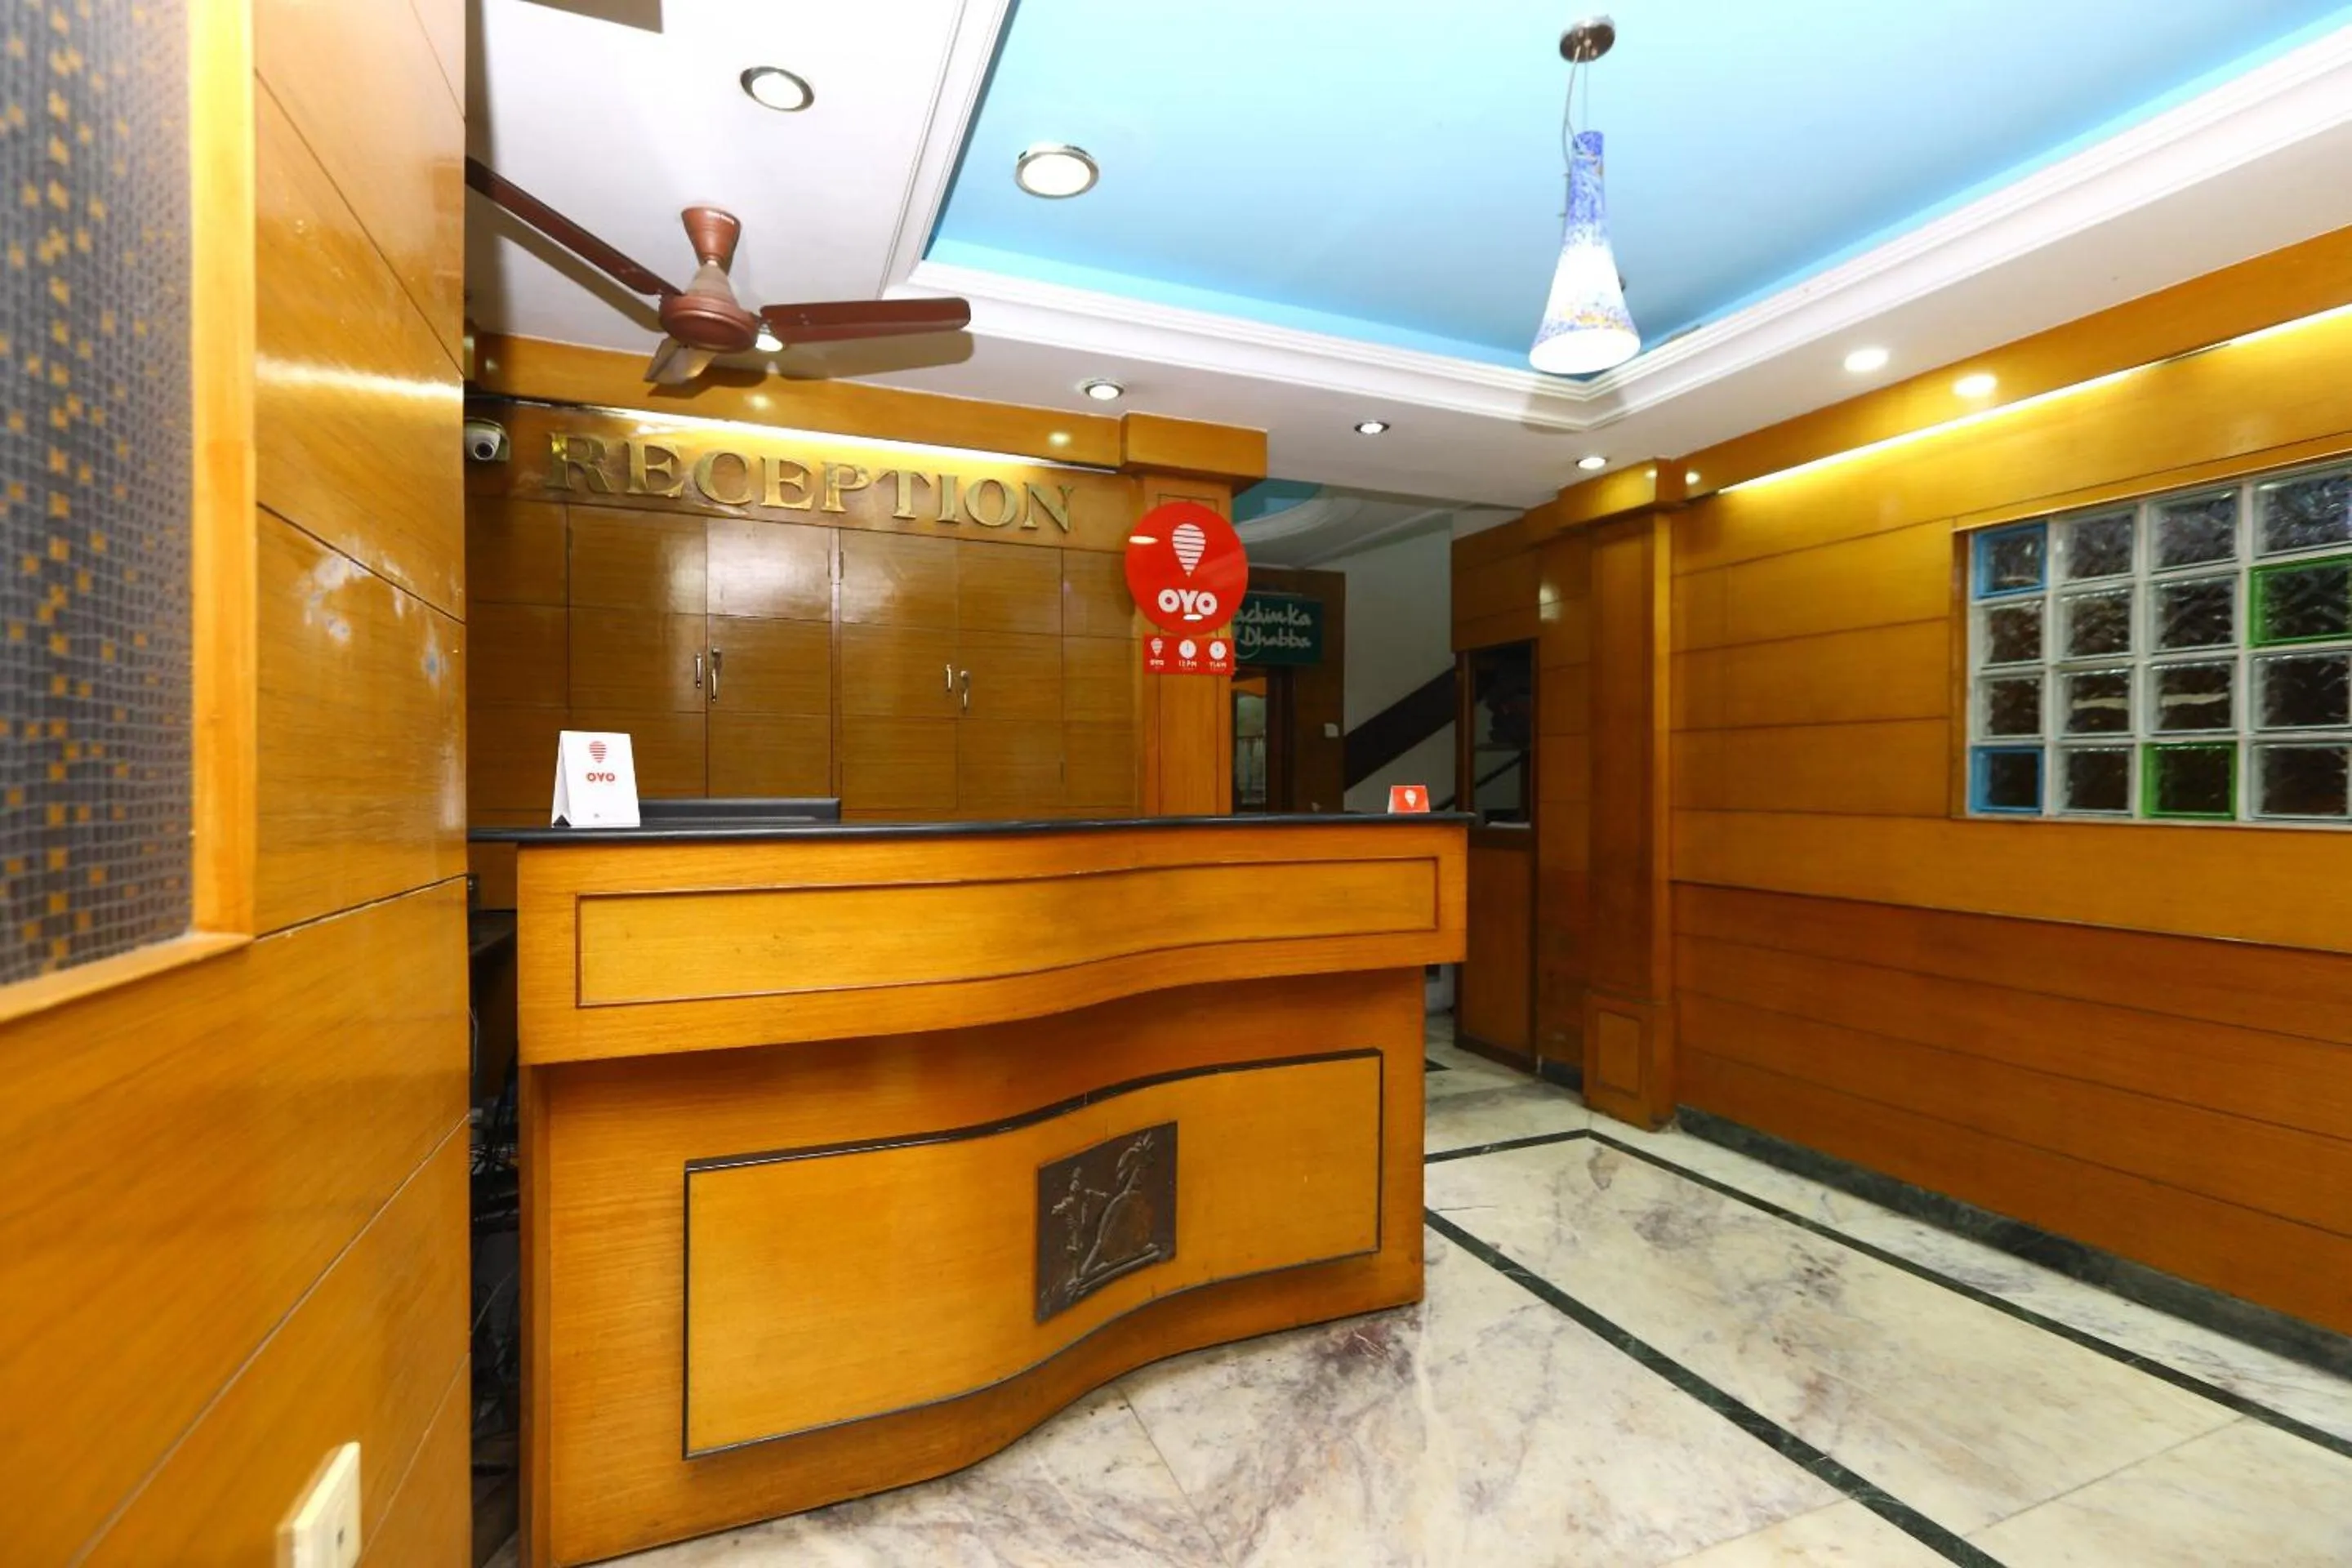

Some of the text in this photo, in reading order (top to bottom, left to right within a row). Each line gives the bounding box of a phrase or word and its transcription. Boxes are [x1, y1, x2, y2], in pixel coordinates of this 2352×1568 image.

[548, 432, 1074, 533] RECEPTION
[1158, 589, 1218, 615] OYO
[586, 773, 616, 782] OYO
